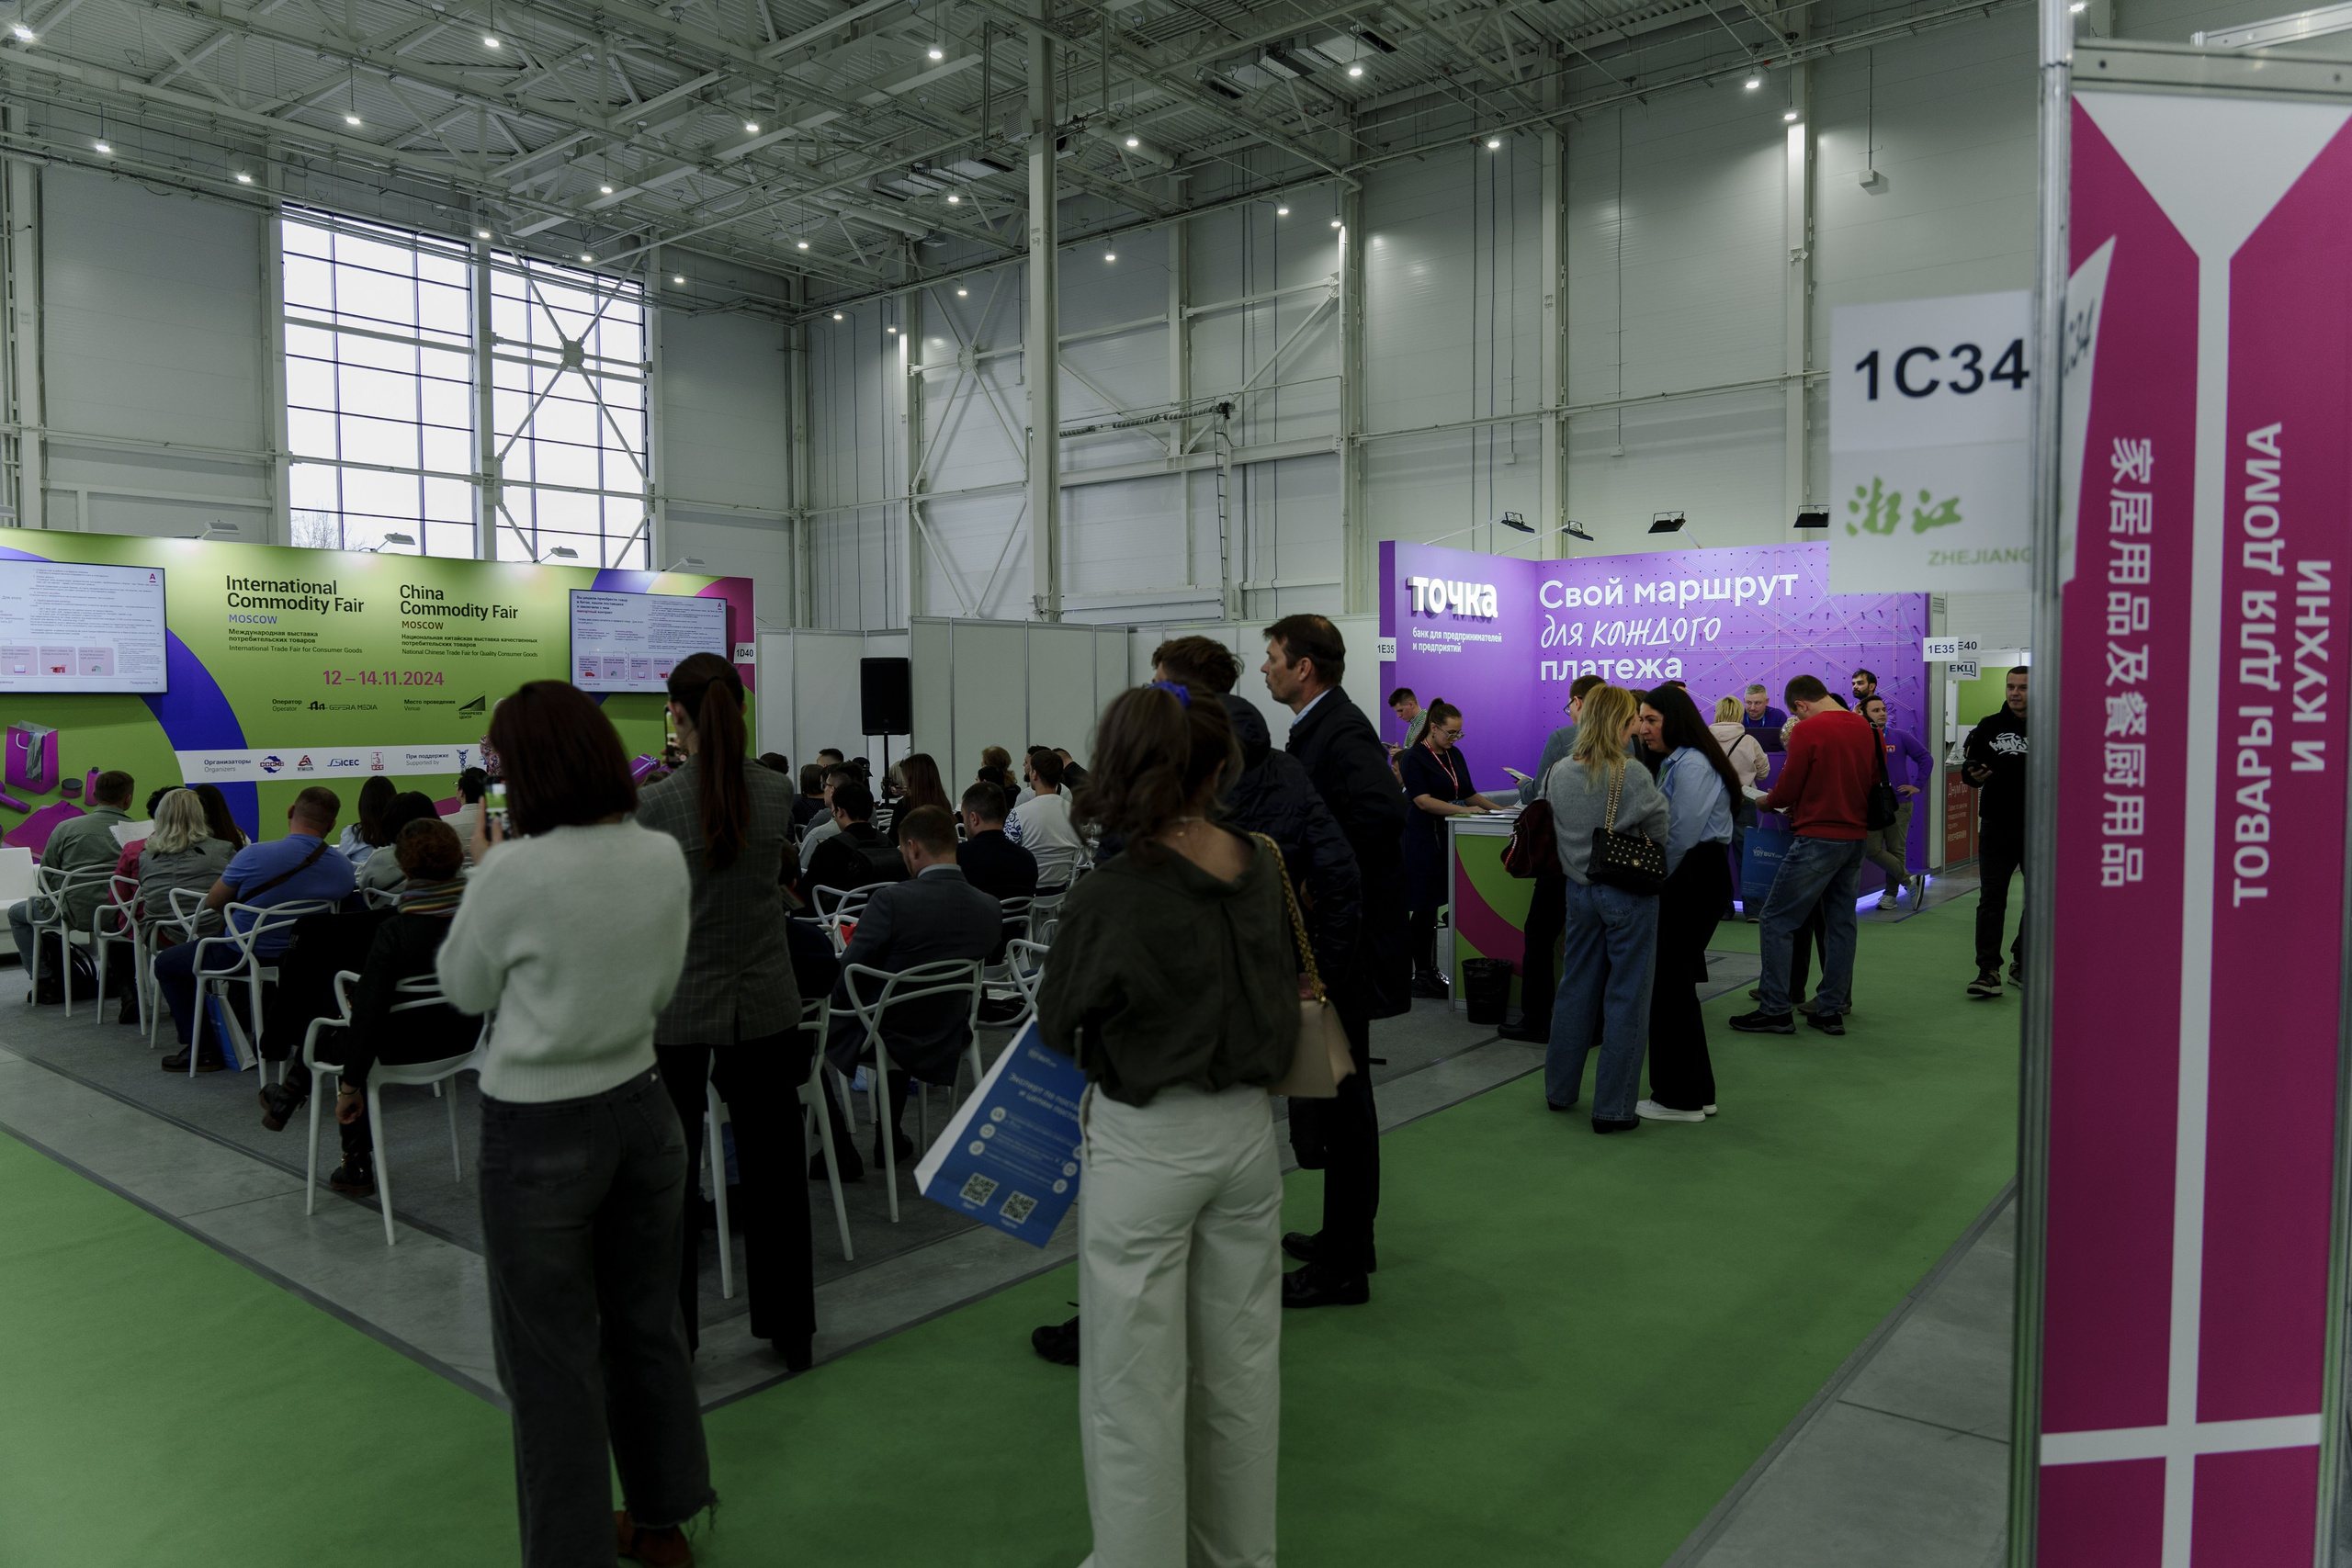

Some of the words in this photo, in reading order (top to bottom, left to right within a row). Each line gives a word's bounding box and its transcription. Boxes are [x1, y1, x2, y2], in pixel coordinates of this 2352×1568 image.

[1854, 337, 2030, 401] 1C34
[2243, 422, 2285, 576] ДОМА
[227, 575, 337, 595] International
[400, 584, 444, 601] China
[1539, 577, 1623, 609] Свой
[1634, 573, 1799, 610] маршрут
[228, 592, 330, 615] Commodity
[334, 597, 365, 613] Fair
[400, 600, 489, 621] Commodity
[492, 604, 518, 619] Fair
[229, 614, 277, 625] MOSCOW
[401, 620, 444, 630] MOSCOW
[229, 628, 286, 637] Международная
[229, 636, 288, 644] потребительских
[1412, 626, 1429, 638] банк
[1430, 630, 1442, 640] для
[1442, 632, 1502, 644] предпринимателей
[1540, 614, 1583, 649] для
[1590, 616, 1722, 649] каждого
[2239, 591, 2282, 692] ДЛЯ
[2291, 559, 2332, 723] КУХНИ
[229, 644, 269, 652] International
[736, 648, 754, 658] 1D40
[1377, 644, 1395, 654] 1E35
[1419, 641, 1462, 654] предприятий
[1928, 644, 1955, 654] 1E35
[1540, 657, 1683, 682] платежа
[2100, 436, 2154, 886] 家居用品及餐厨用品
[323, 670, 342, 685] 12
[358, 671, 445, 686] 14.11.2024
[2290, 740, 2326, 773] И
[2233, 706, 2274, 908] ТОВАРЫ
